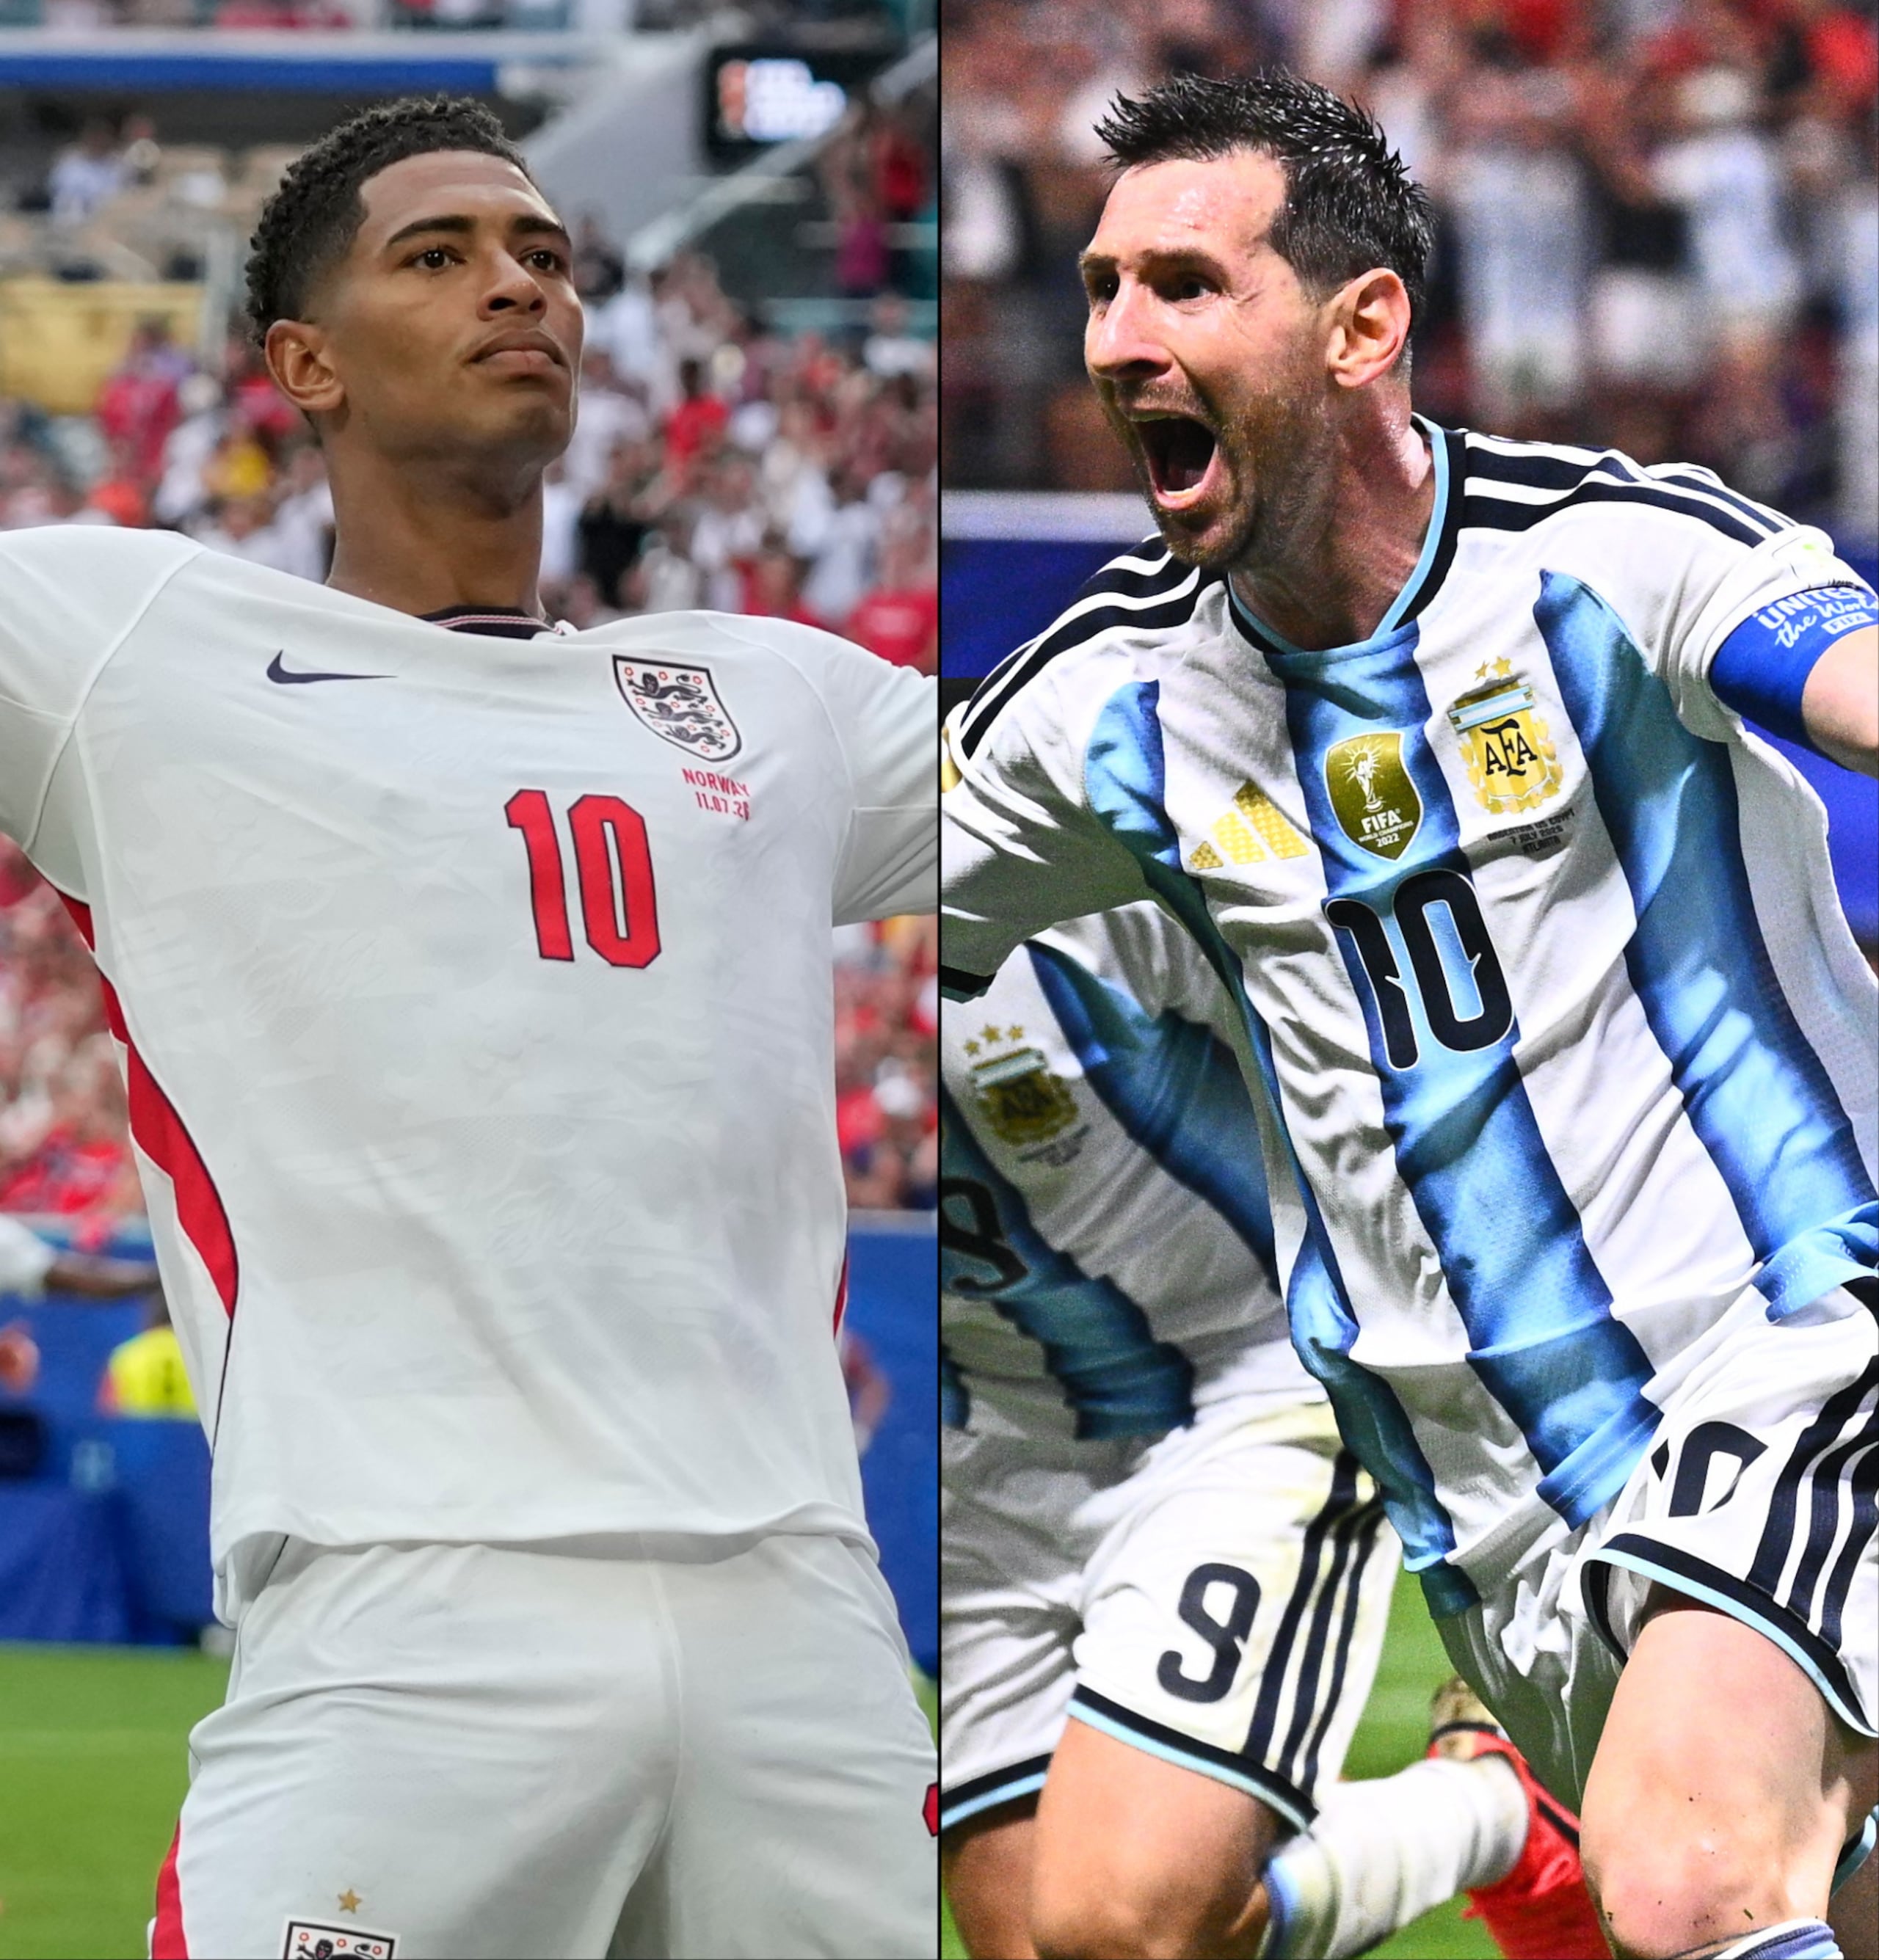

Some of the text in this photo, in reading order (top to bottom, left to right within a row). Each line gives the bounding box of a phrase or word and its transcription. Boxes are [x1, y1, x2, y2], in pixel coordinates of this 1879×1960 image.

[1775, 621, 1817, 648] the
[1830, 615, 1864, 630] FIFA
[1480, 718, 1538, 776] AFA
[682, 768, 750, 797] NORWAY
[1361, 809, 1402, 834] FIFA
[1375, 833, 1400, 848] 2022
[505, 789, 661, 969] 10
[1324, 869, 1515, 1071] 10
[1157, 1562, 1262, 1703] 9
